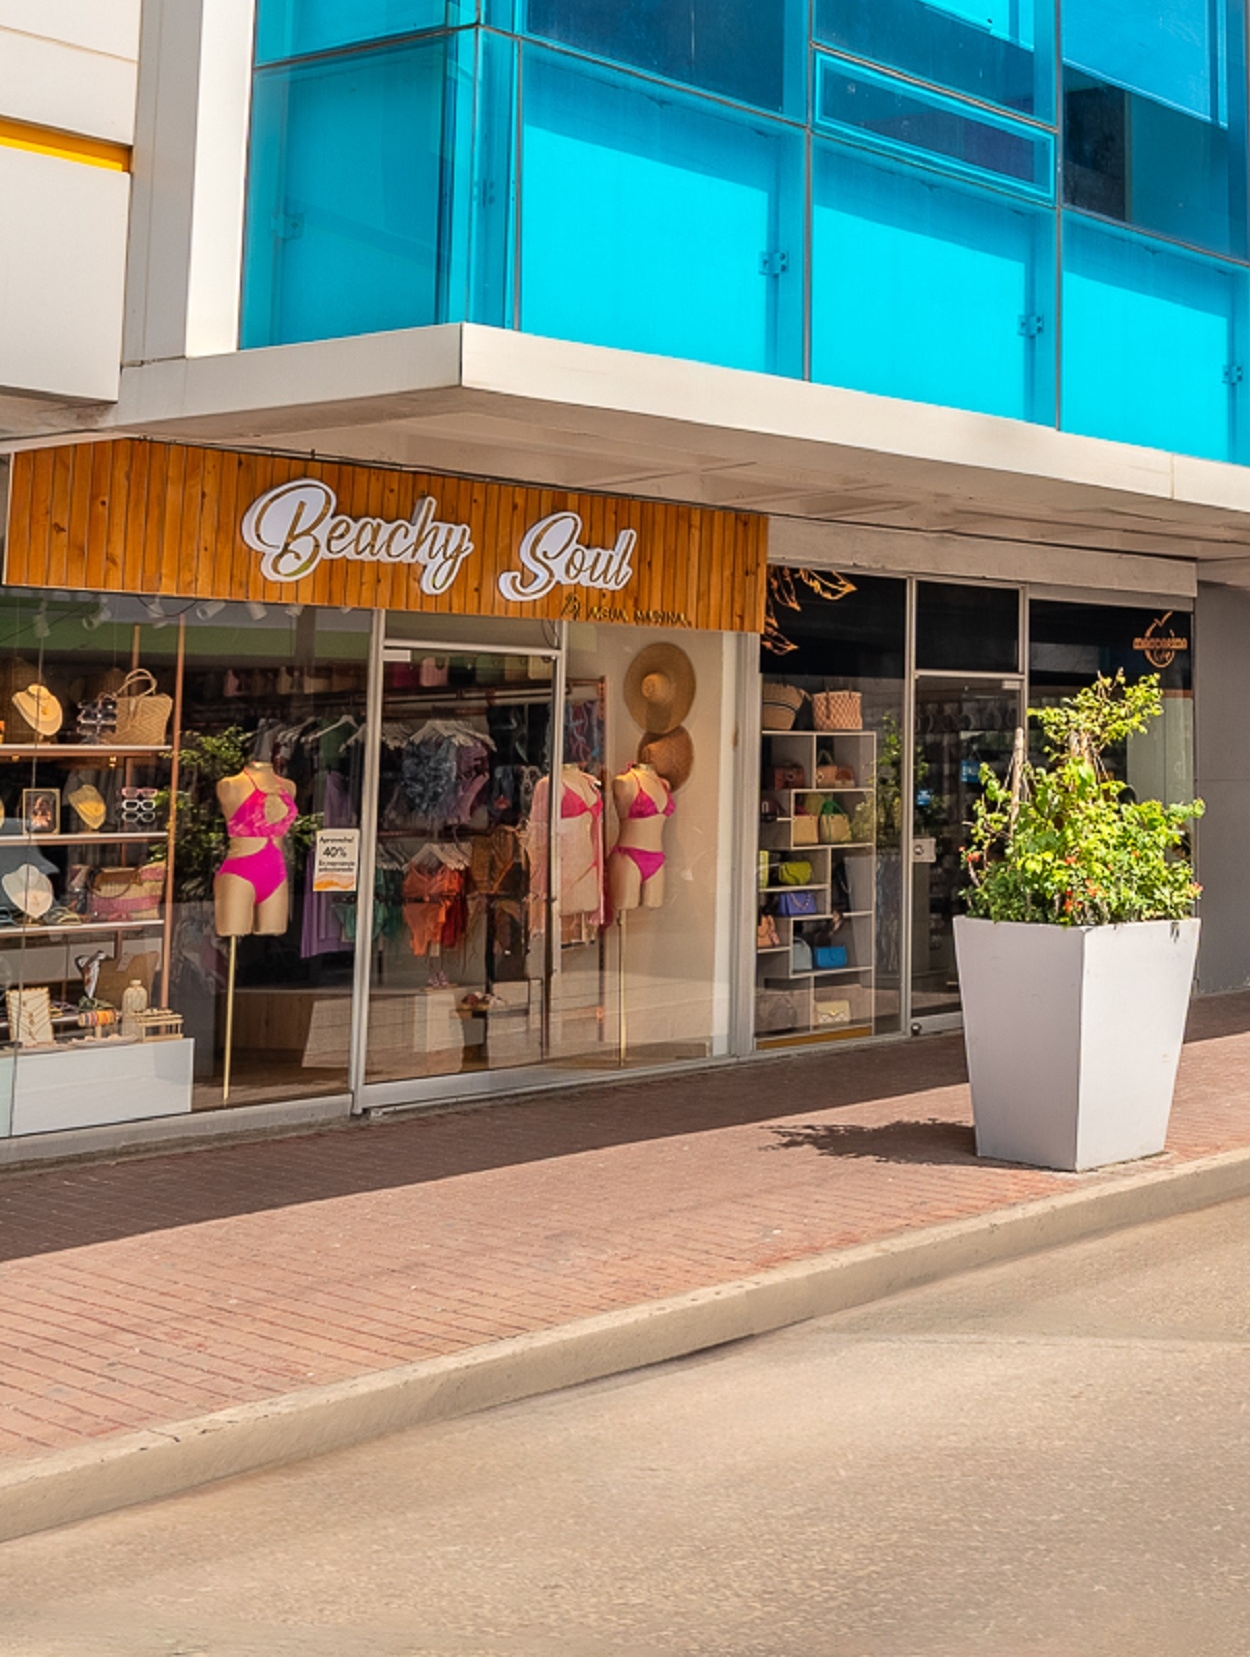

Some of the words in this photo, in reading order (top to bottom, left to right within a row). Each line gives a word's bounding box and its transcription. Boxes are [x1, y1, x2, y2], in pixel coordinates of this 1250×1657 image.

[242, 478, 473, 595] Beachy
[499, 511, 637, 602] Soul
[322, 846, 347, 858] 40%
